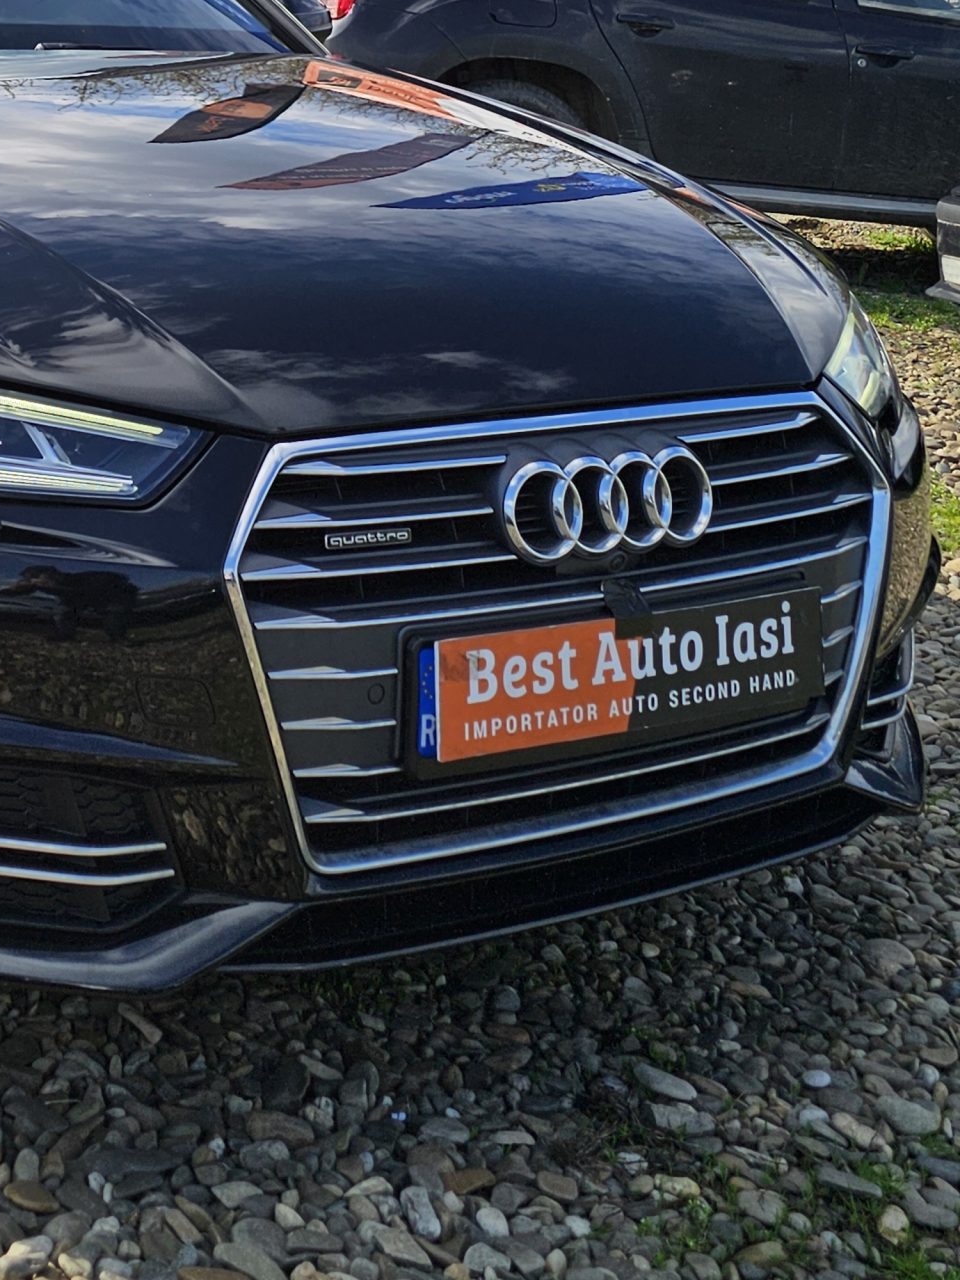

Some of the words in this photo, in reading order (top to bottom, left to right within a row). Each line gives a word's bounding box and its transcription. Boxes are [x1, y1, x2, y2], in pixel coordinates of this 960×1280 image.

[330, 531, 408, 547] quattro
[466, 641, 579, 704] Best
[592, 626, 704, 686] Auto
[715, 600, 795, 666] Iasi
[464, 703, 598, 741] IMPORTATOR
[609, 693, 659, 718] AUTO
[669, 679, 741, 708] SECOND
[749, 669, 796, 694] HAND
